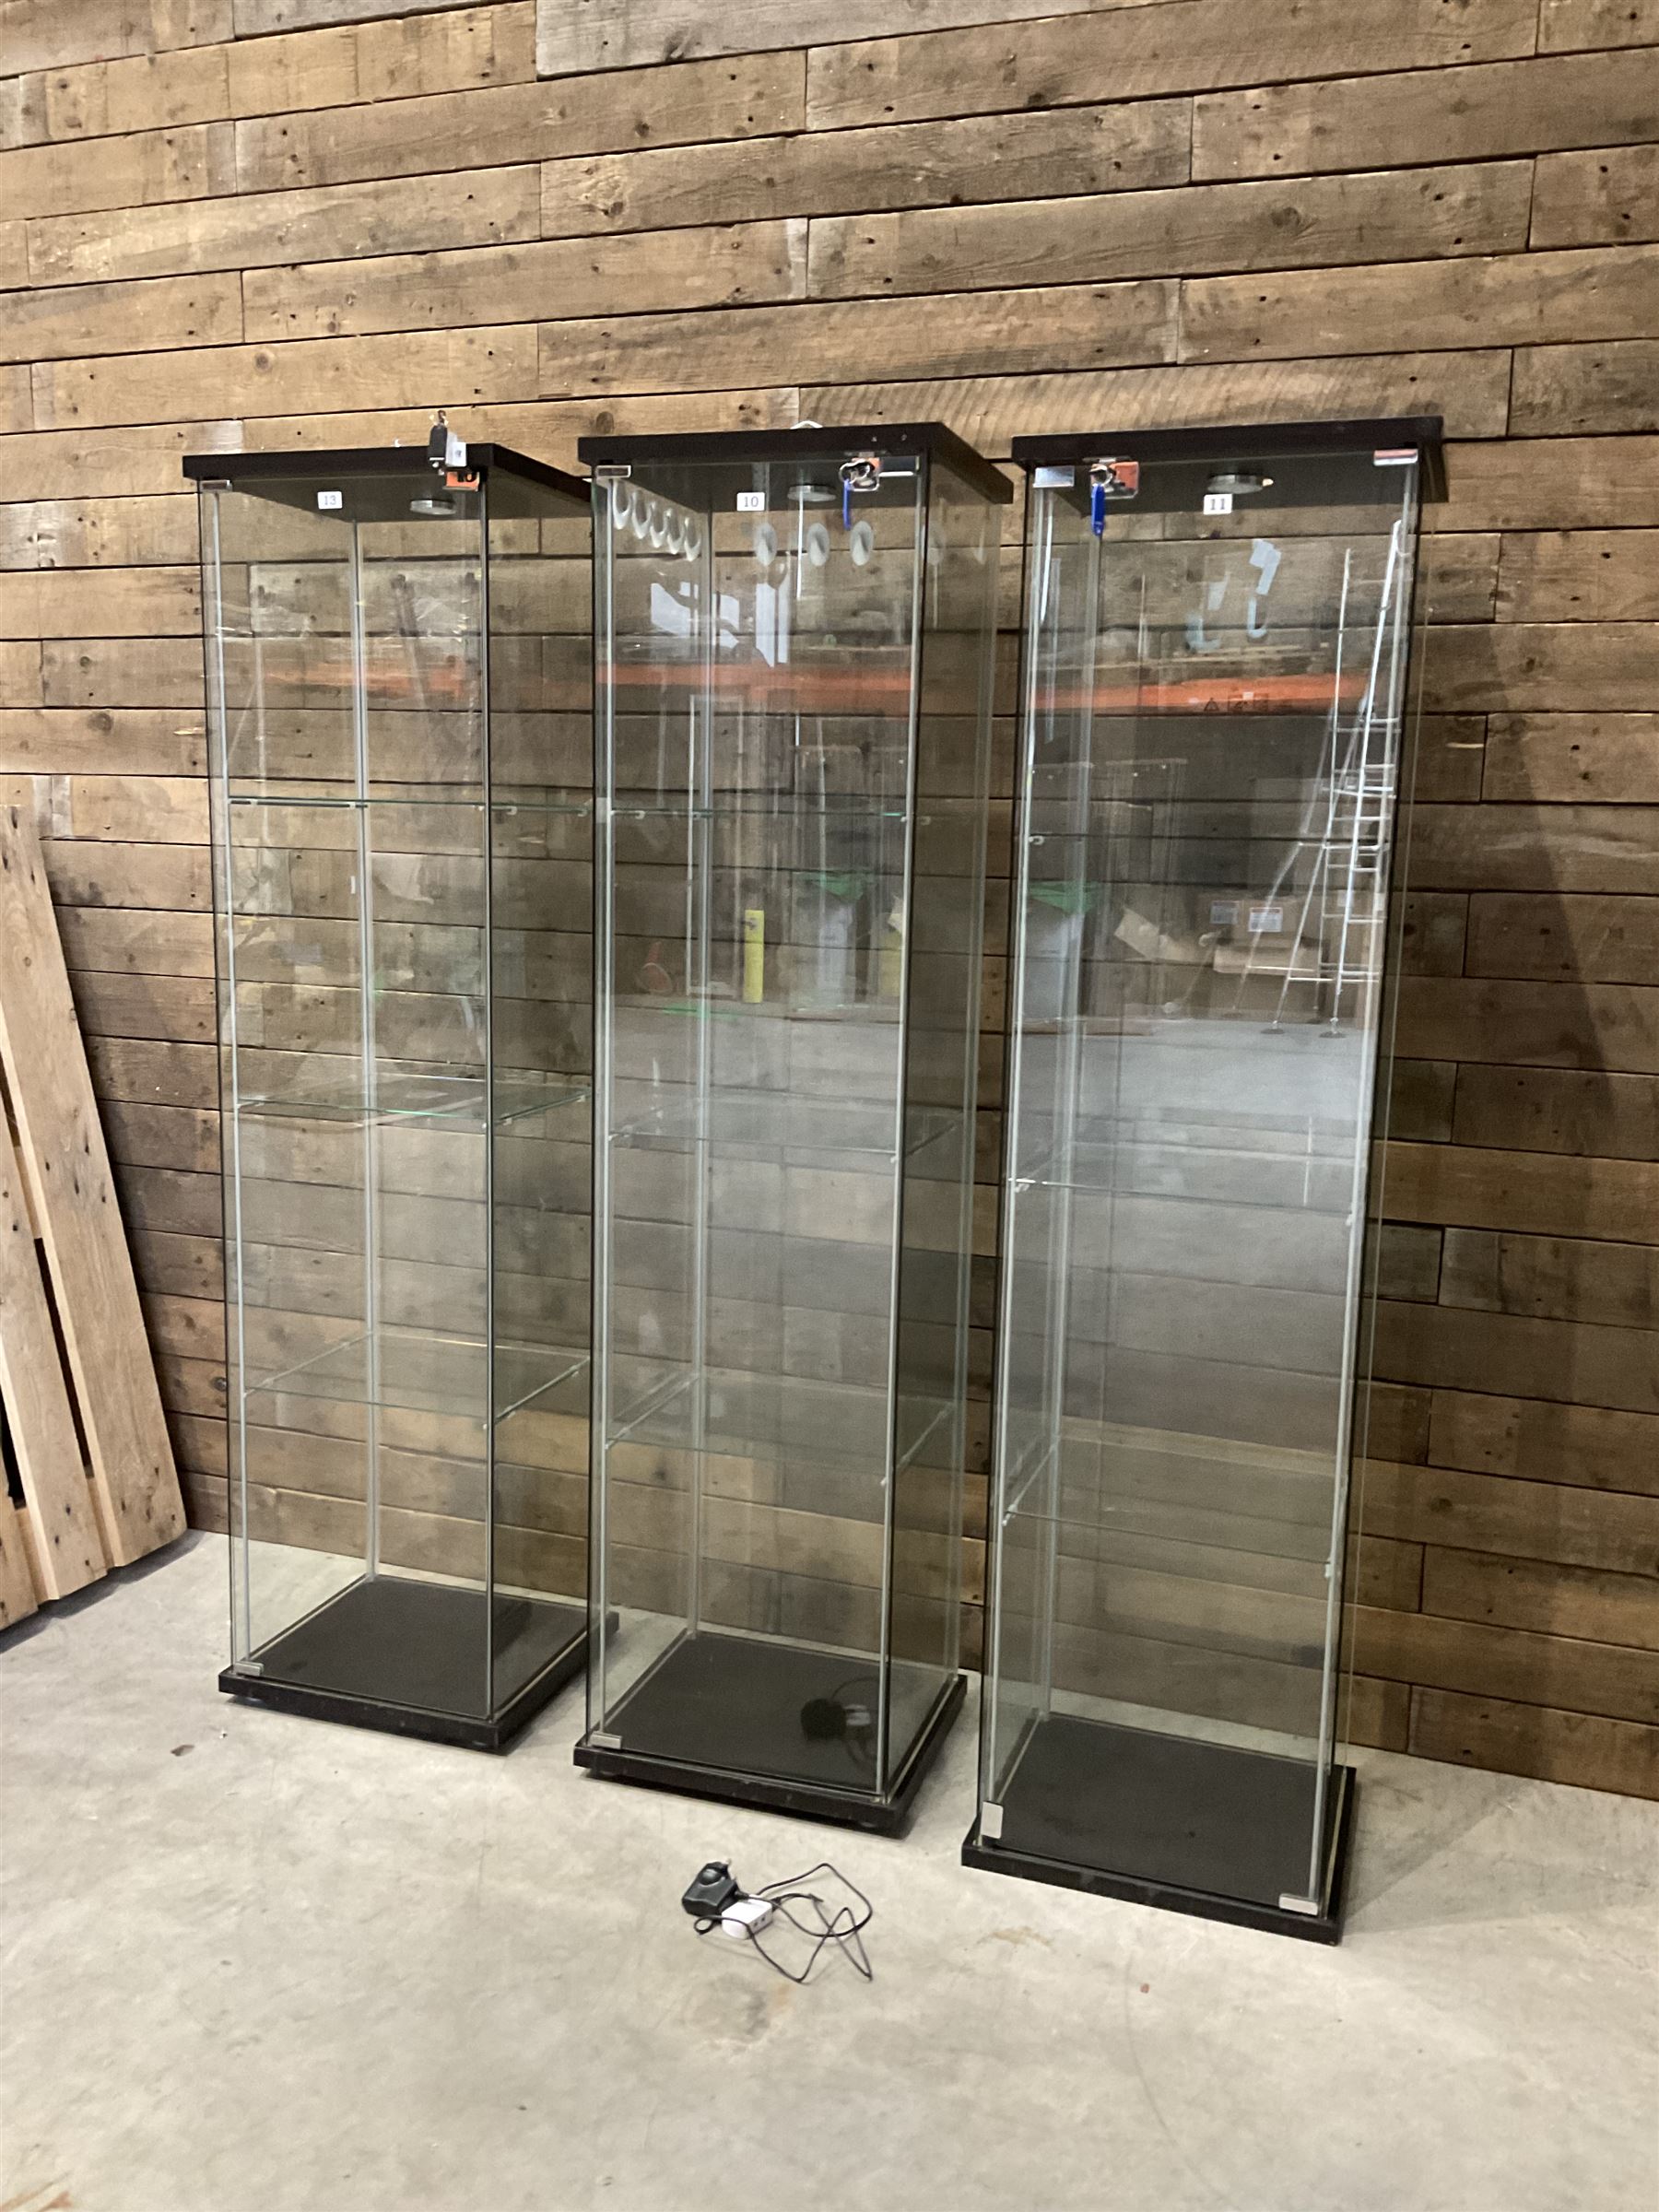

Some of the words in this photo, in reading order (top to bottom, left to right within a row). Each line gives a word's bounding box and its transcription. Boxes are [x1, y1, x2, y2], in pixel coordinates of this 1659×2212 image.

[324, 494, 337, 506] 13
[744, 495, 759, 508] 10
[1209, 498, 1226, 511] 11
